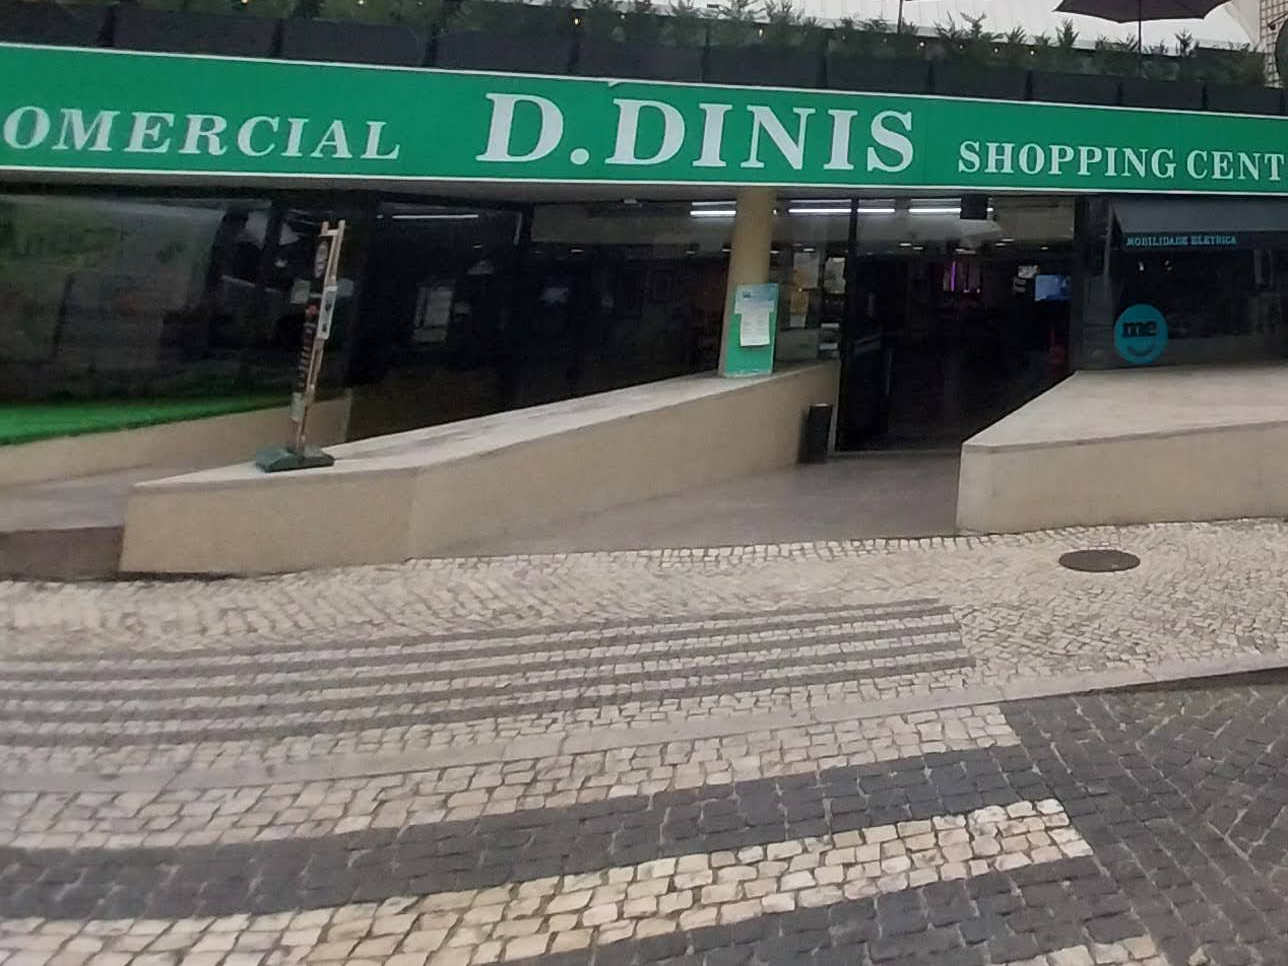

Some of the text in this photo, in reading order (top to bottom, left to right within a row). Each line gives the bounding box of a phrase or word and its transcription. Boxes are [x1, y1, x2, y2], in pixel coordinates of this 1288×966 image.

[2, 106, 400, 160] OMERCIAL
[958, 140, 1177, 179] SHOPPING
[1126, 235, 1188, 247] MOBILIDADE
[1122, 320, 1157, 339] me
